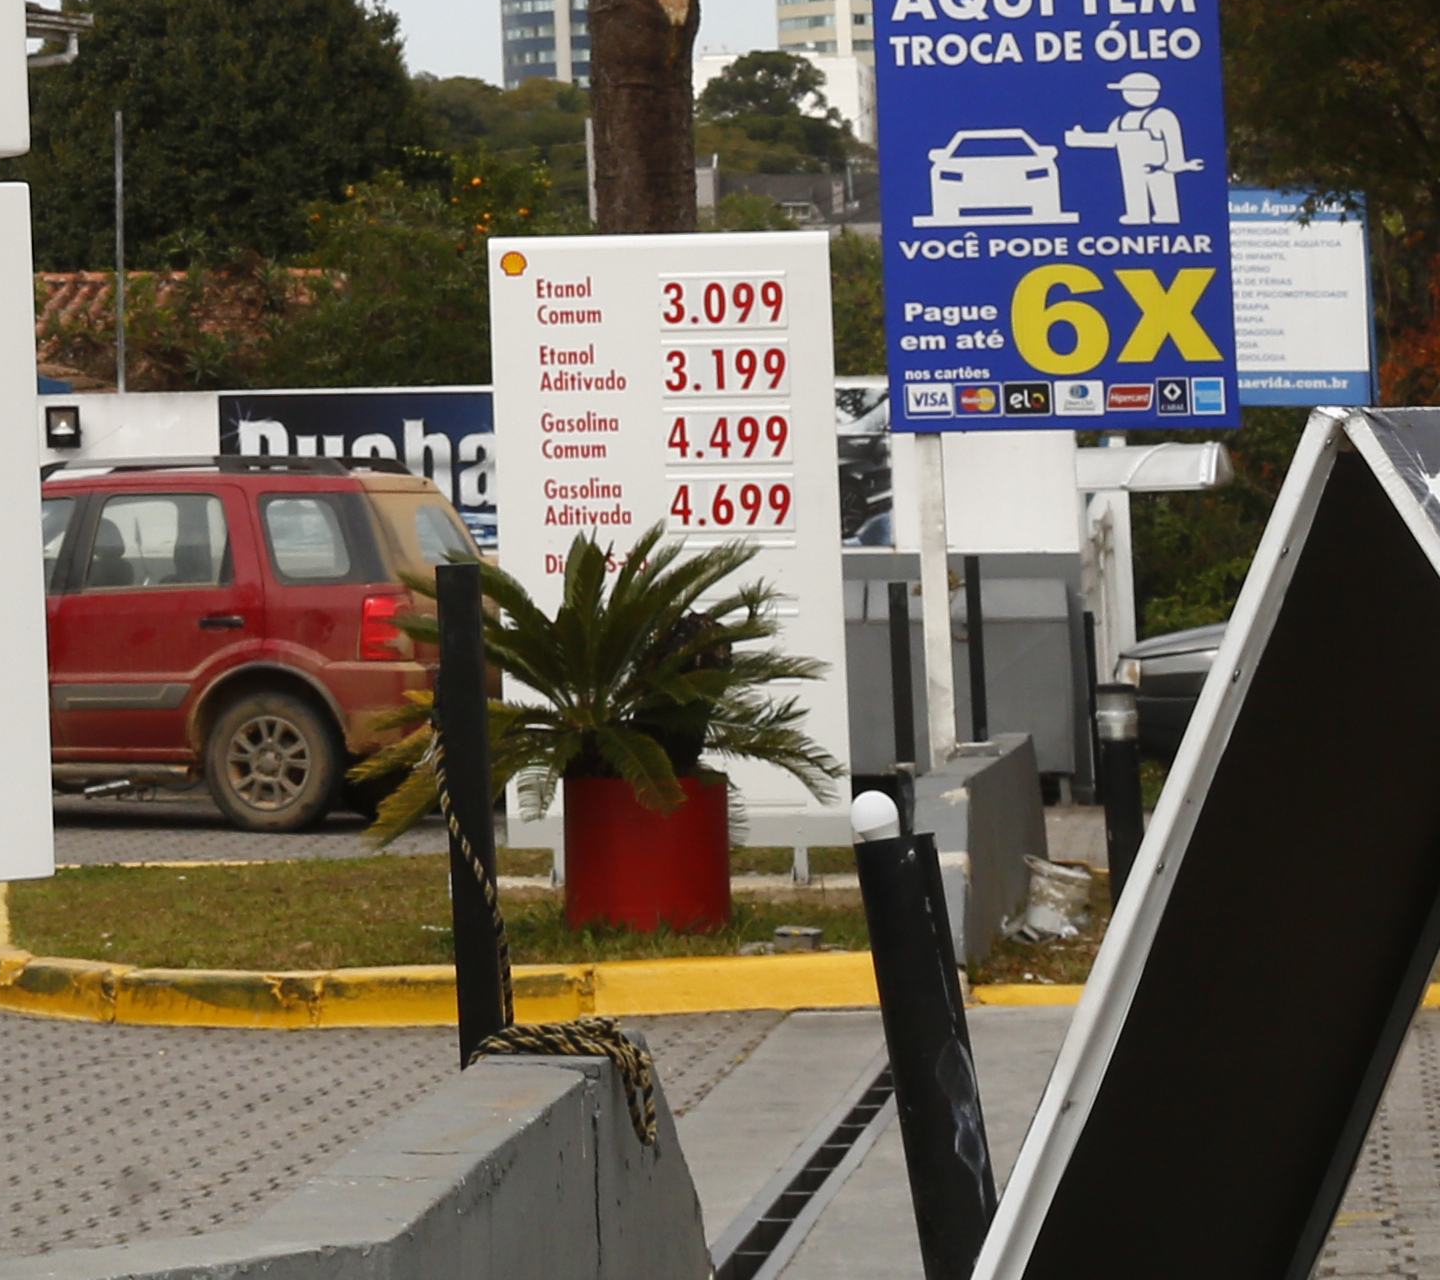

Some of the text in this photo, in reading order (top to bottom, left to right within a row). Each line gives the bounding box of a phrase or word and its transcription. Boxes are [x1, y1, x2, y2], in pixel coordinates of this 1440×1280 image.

[889, 20, 1202, 67] TROCA DE ÓLEO
[1260, 199, 1297, 216] Água
[899, 231, 1213, 260] VOCÊ PODE CONFIAR
[536, 276, 784, 324] Etanol 3.099
[537, 305, 602, 325] Comum
[904, 301, 999, 326] Pague
[1010, 262, 1225, 376] 6X
[900, 328, 1005, 351] em até
[539, 344, 787, 392] Etanol 3.199
[904, 364, 991, 380] nos cartões
[540, 369, 627, 392] Aditivado
[913, 391, 949, 408] VISA
[1009, 389, 1046, 409] elo
[541, 411, 788, 459] Gasolina 4.499
[542, 439, 607, 459] Comum
[544, 478, 792, 526] Gasolina 4.699
[545, 503, 633, 527] Aditivada
